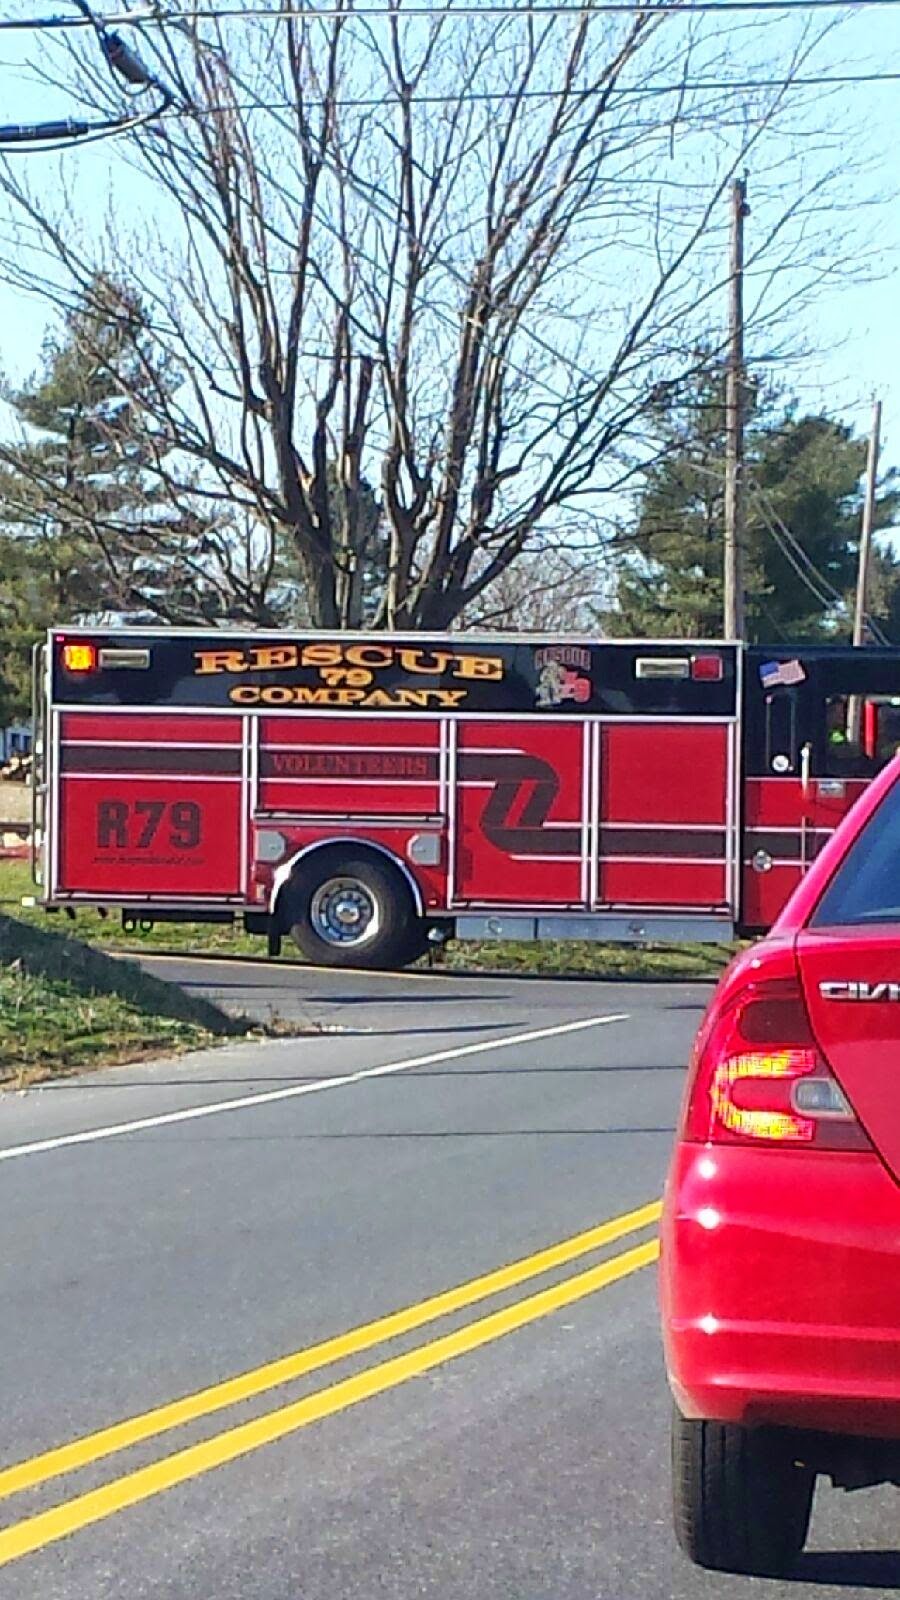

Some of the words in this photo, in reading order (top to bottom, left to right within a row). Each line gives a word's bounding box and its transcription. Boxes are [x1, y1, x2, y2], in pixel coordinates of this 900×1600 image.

[193, 644, 503, 681] RESCUE
[320, 667, 374, 688] 79
[228, 686, 468, 706] COMPANY
[272, 753, 428, 775] VOLUNTEERS
[97, 801, 202, 849] R79
[819, 982, 900, 1000] CIVI
